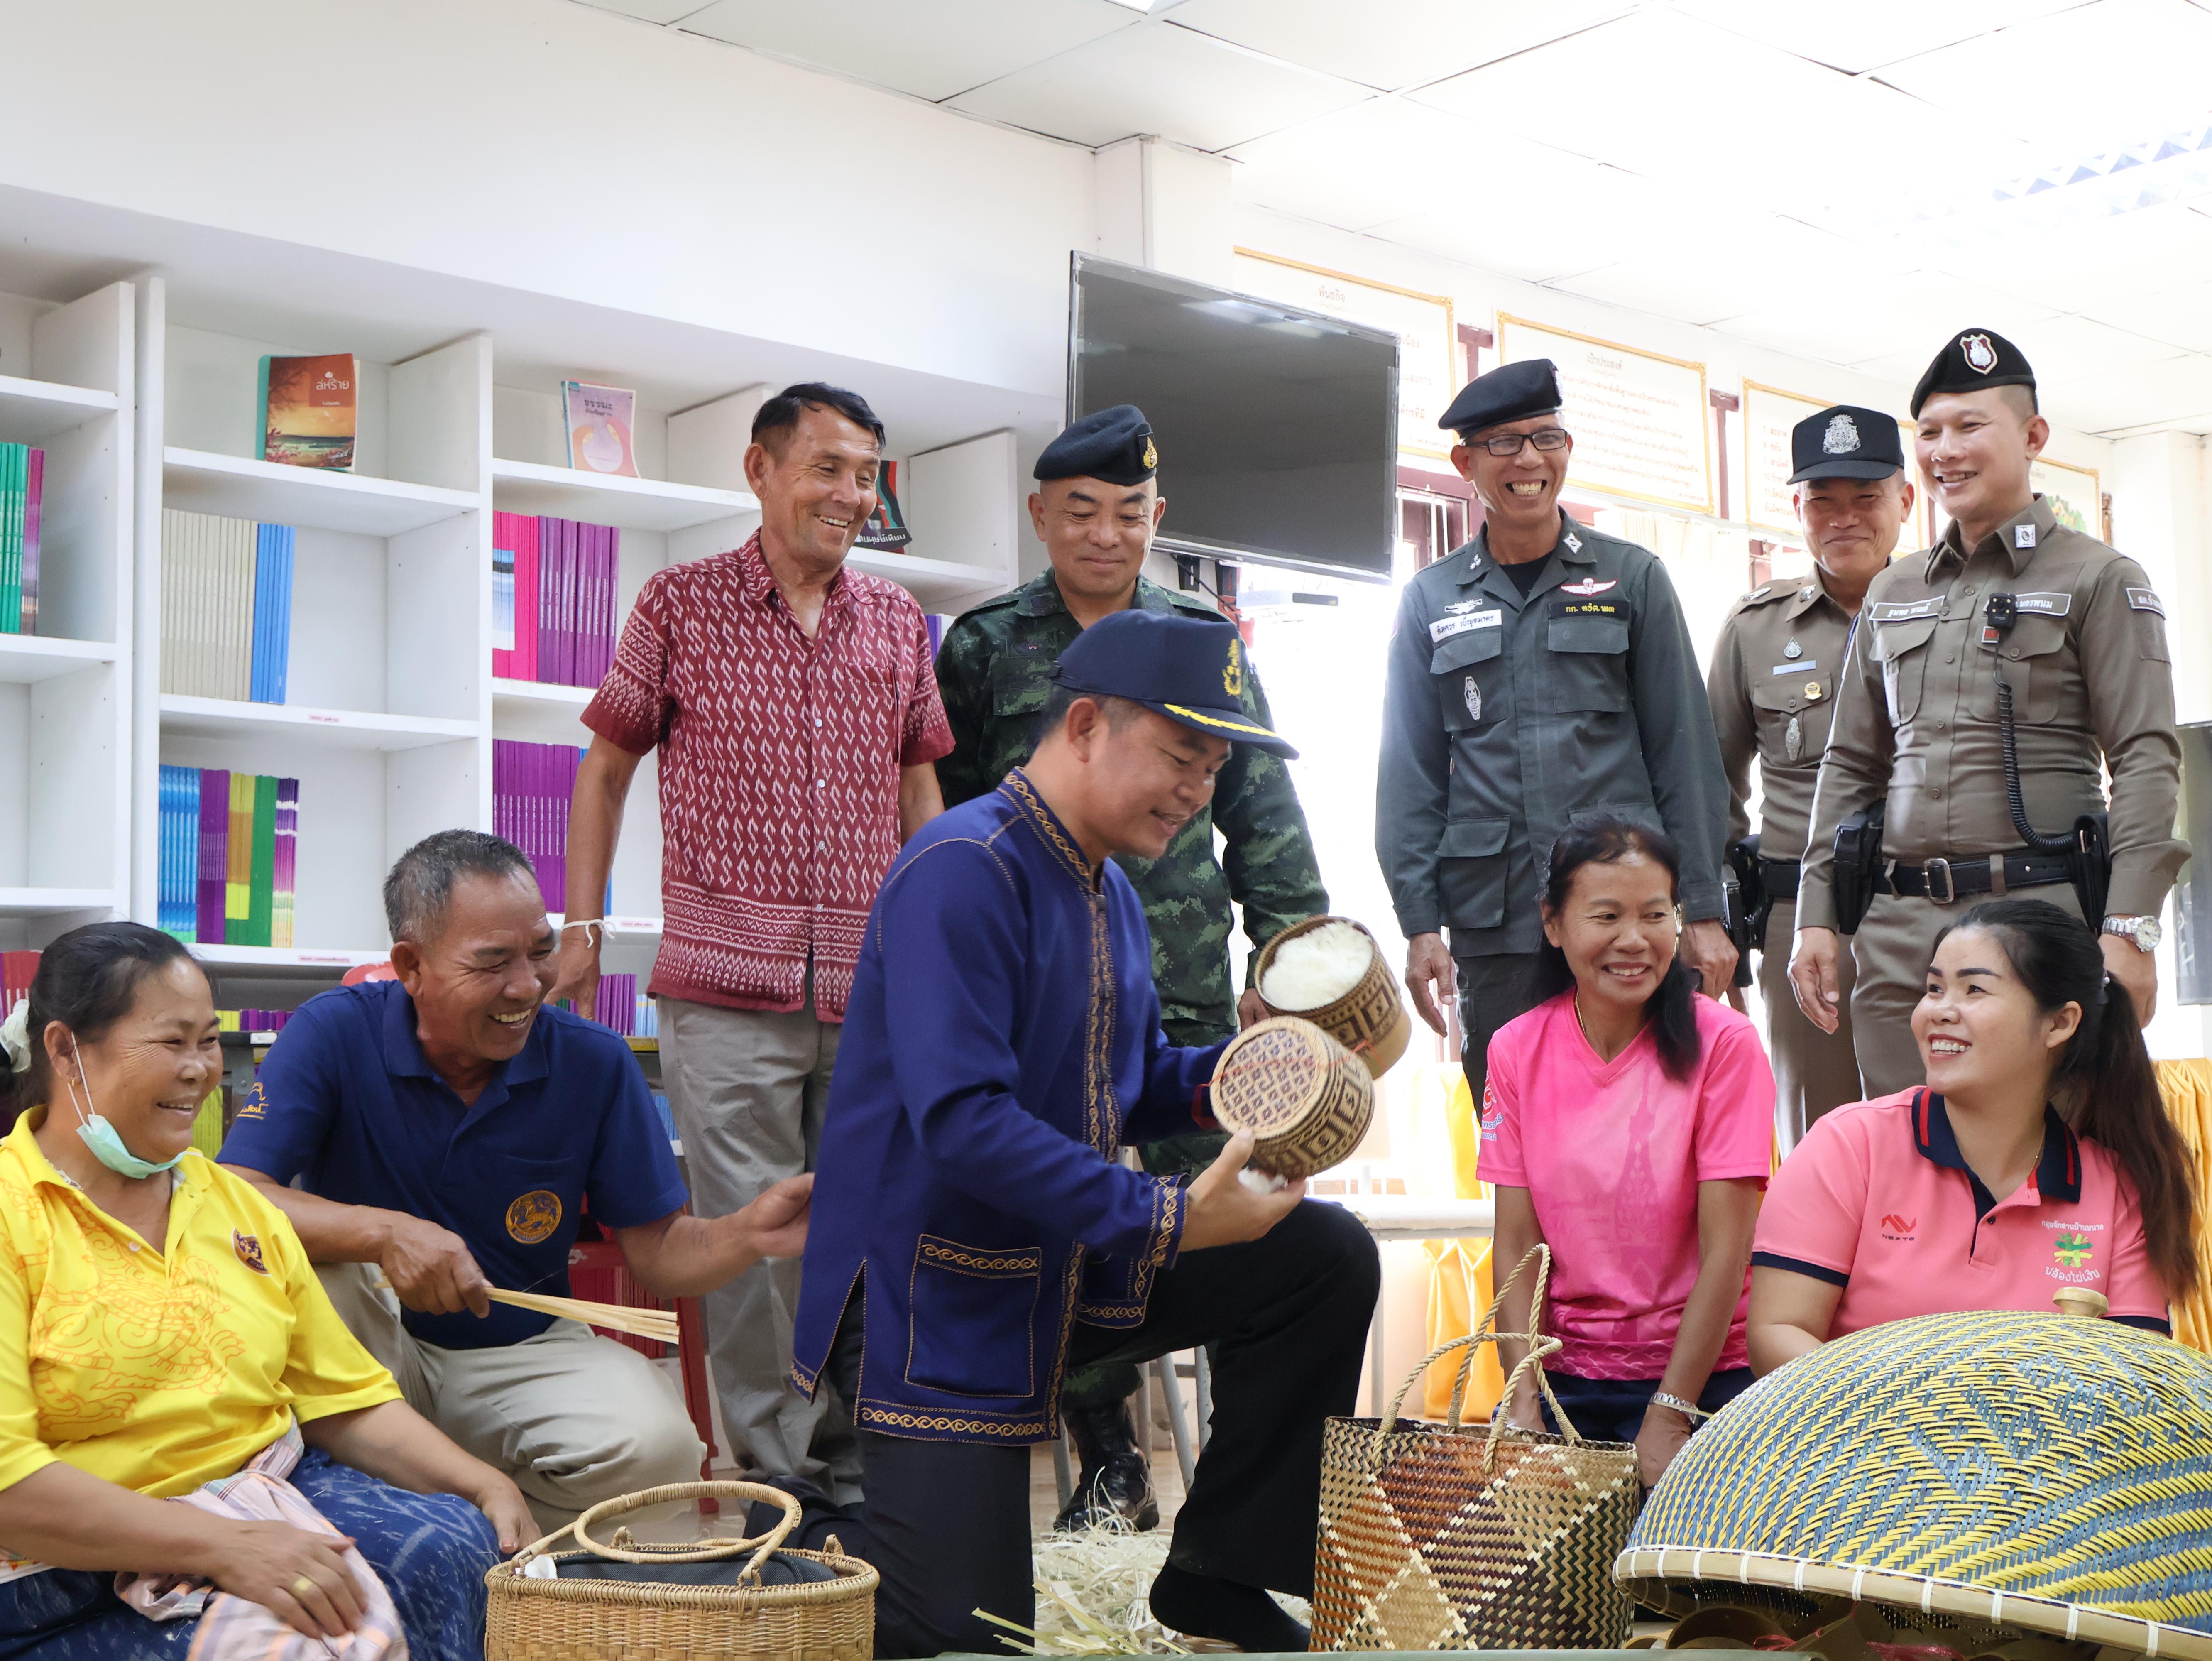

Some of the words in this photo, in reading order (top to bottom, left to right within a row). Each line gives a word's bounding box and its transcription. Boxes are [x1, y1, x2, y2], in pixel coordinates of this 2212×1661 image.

[1318, 285, 1346, 303] พันธกิจ
[1399, 404, 1425, 419] ค์กรที่มี
